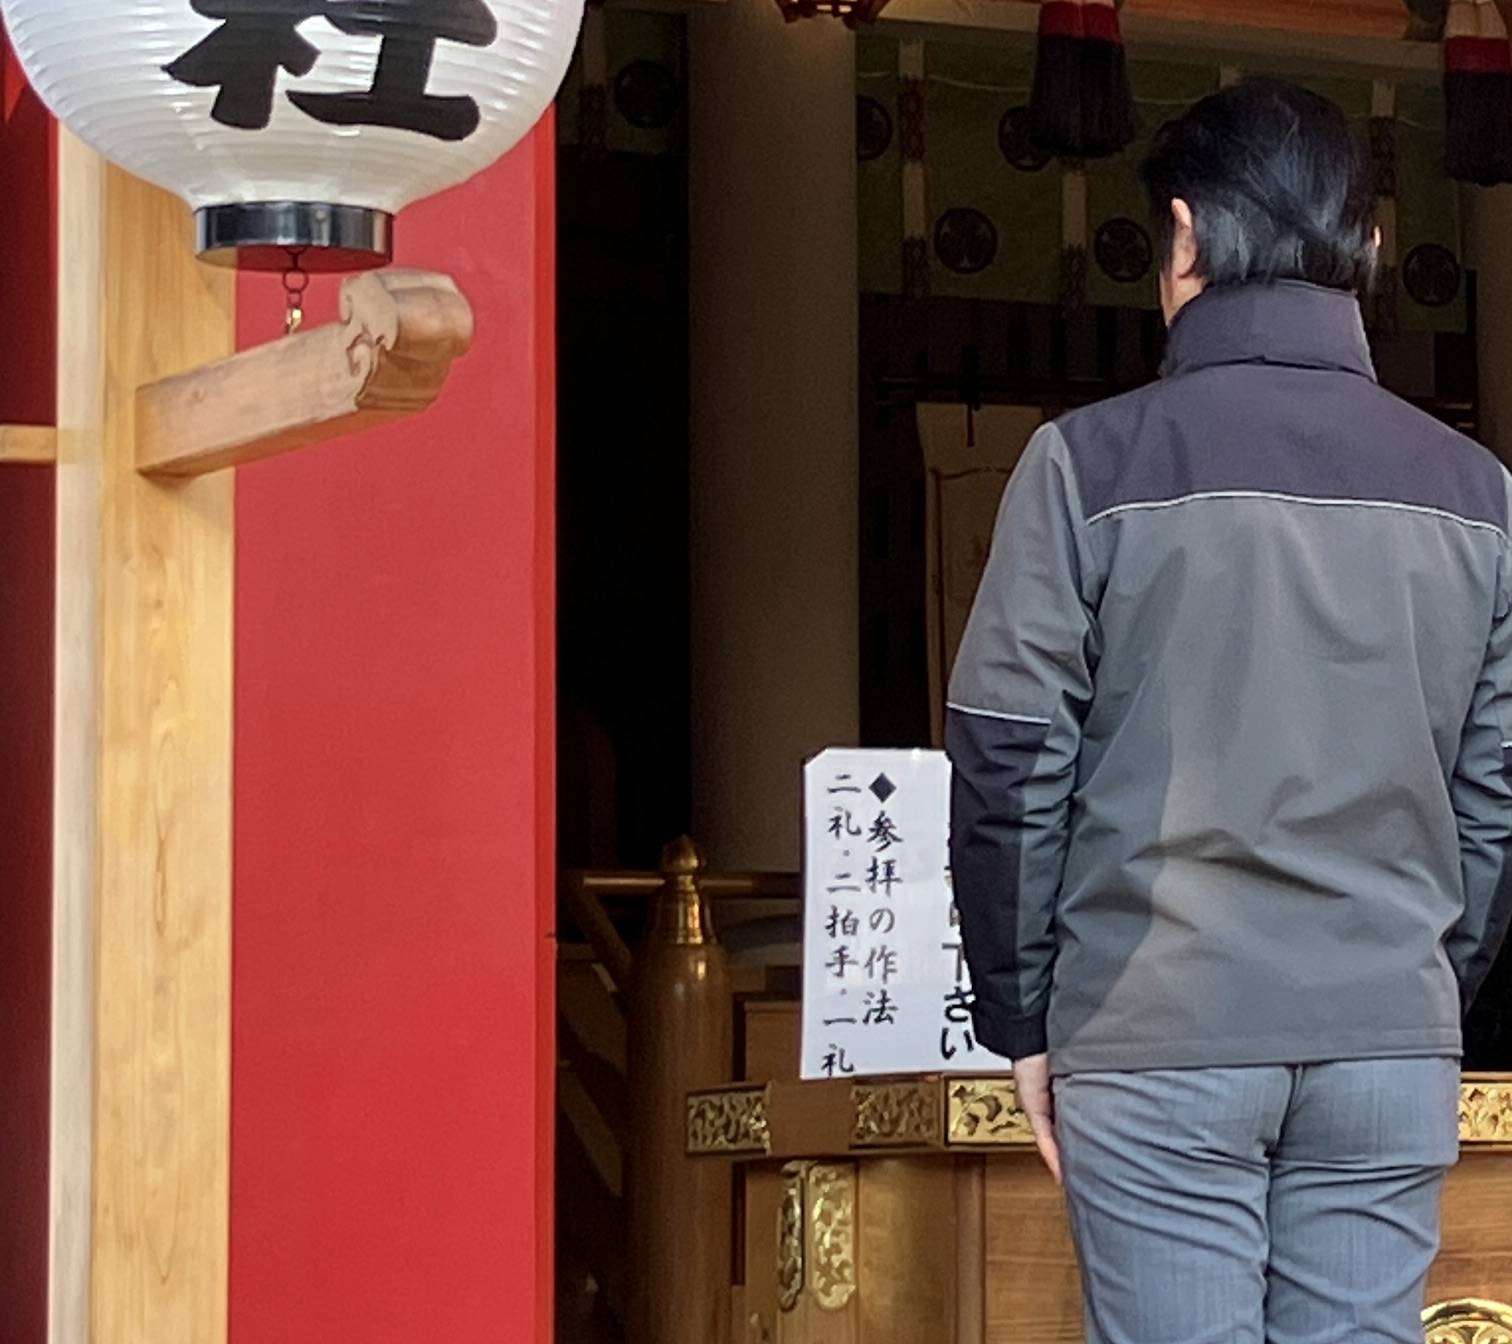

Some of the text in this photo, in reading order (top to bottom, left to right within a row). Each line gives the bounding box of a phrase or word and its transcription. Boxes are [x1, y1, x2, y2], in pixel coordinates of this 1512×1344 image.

[862, 811, 903, 1026] 参拝の作法
